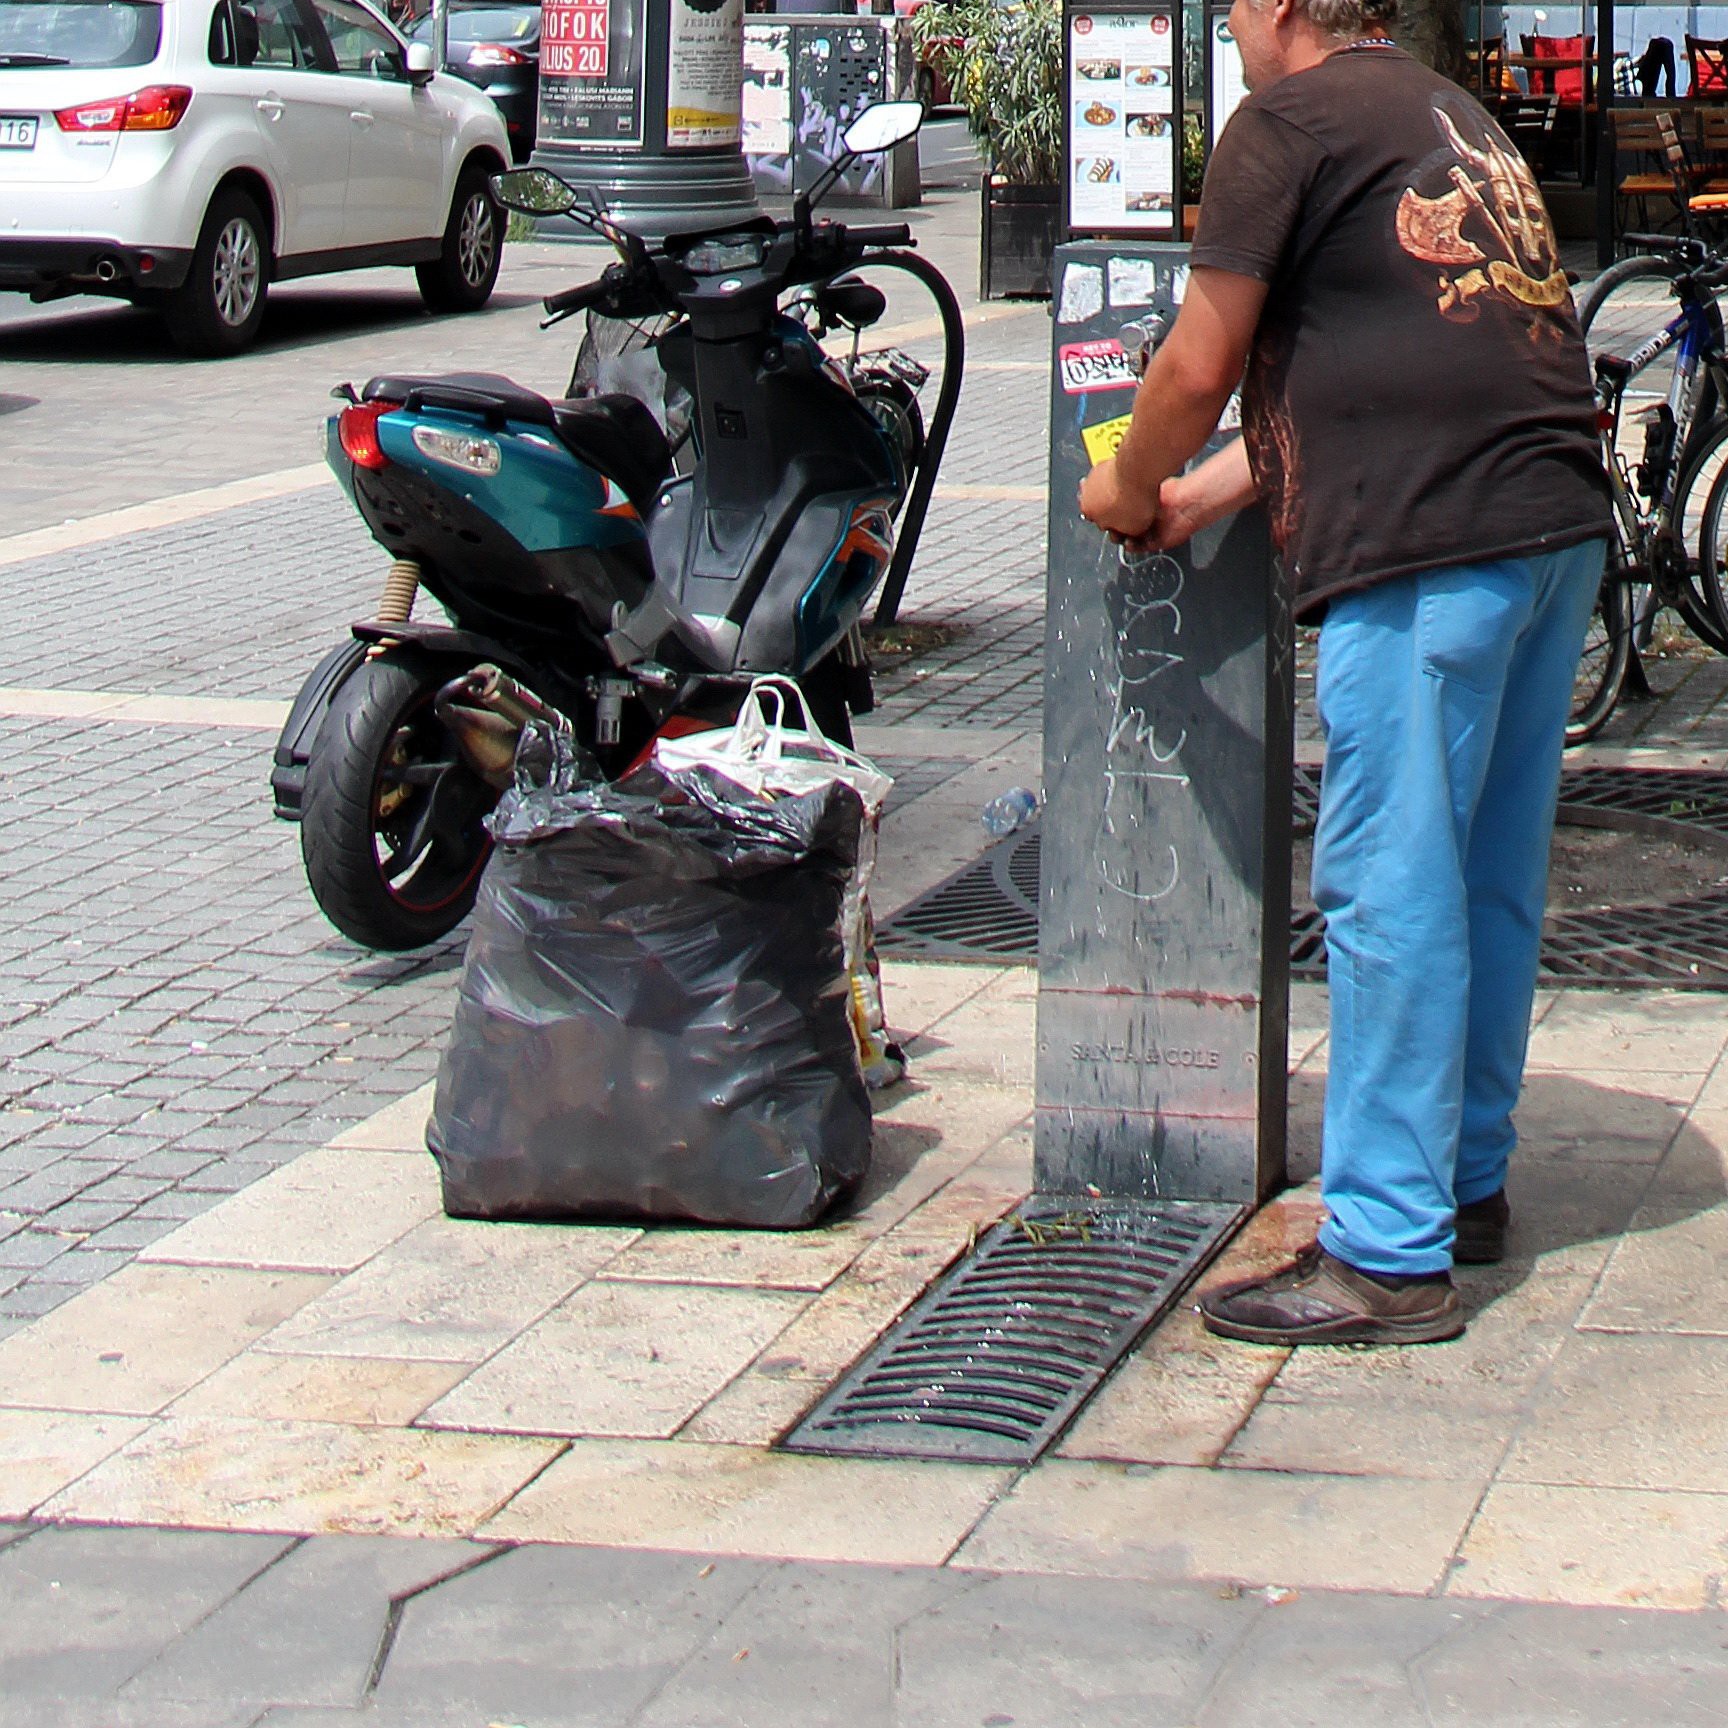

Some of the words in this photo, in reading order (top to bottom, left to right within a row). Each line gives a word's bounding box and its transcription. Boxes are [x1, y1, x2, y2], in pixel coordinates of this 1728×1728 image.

[542, 5, 605, 40] IÓFOK
[541, 45, 573, 71] LIUS
[578, 45, 605, 72] 20.
[1164, 1047, 1220, 1069] COLE
